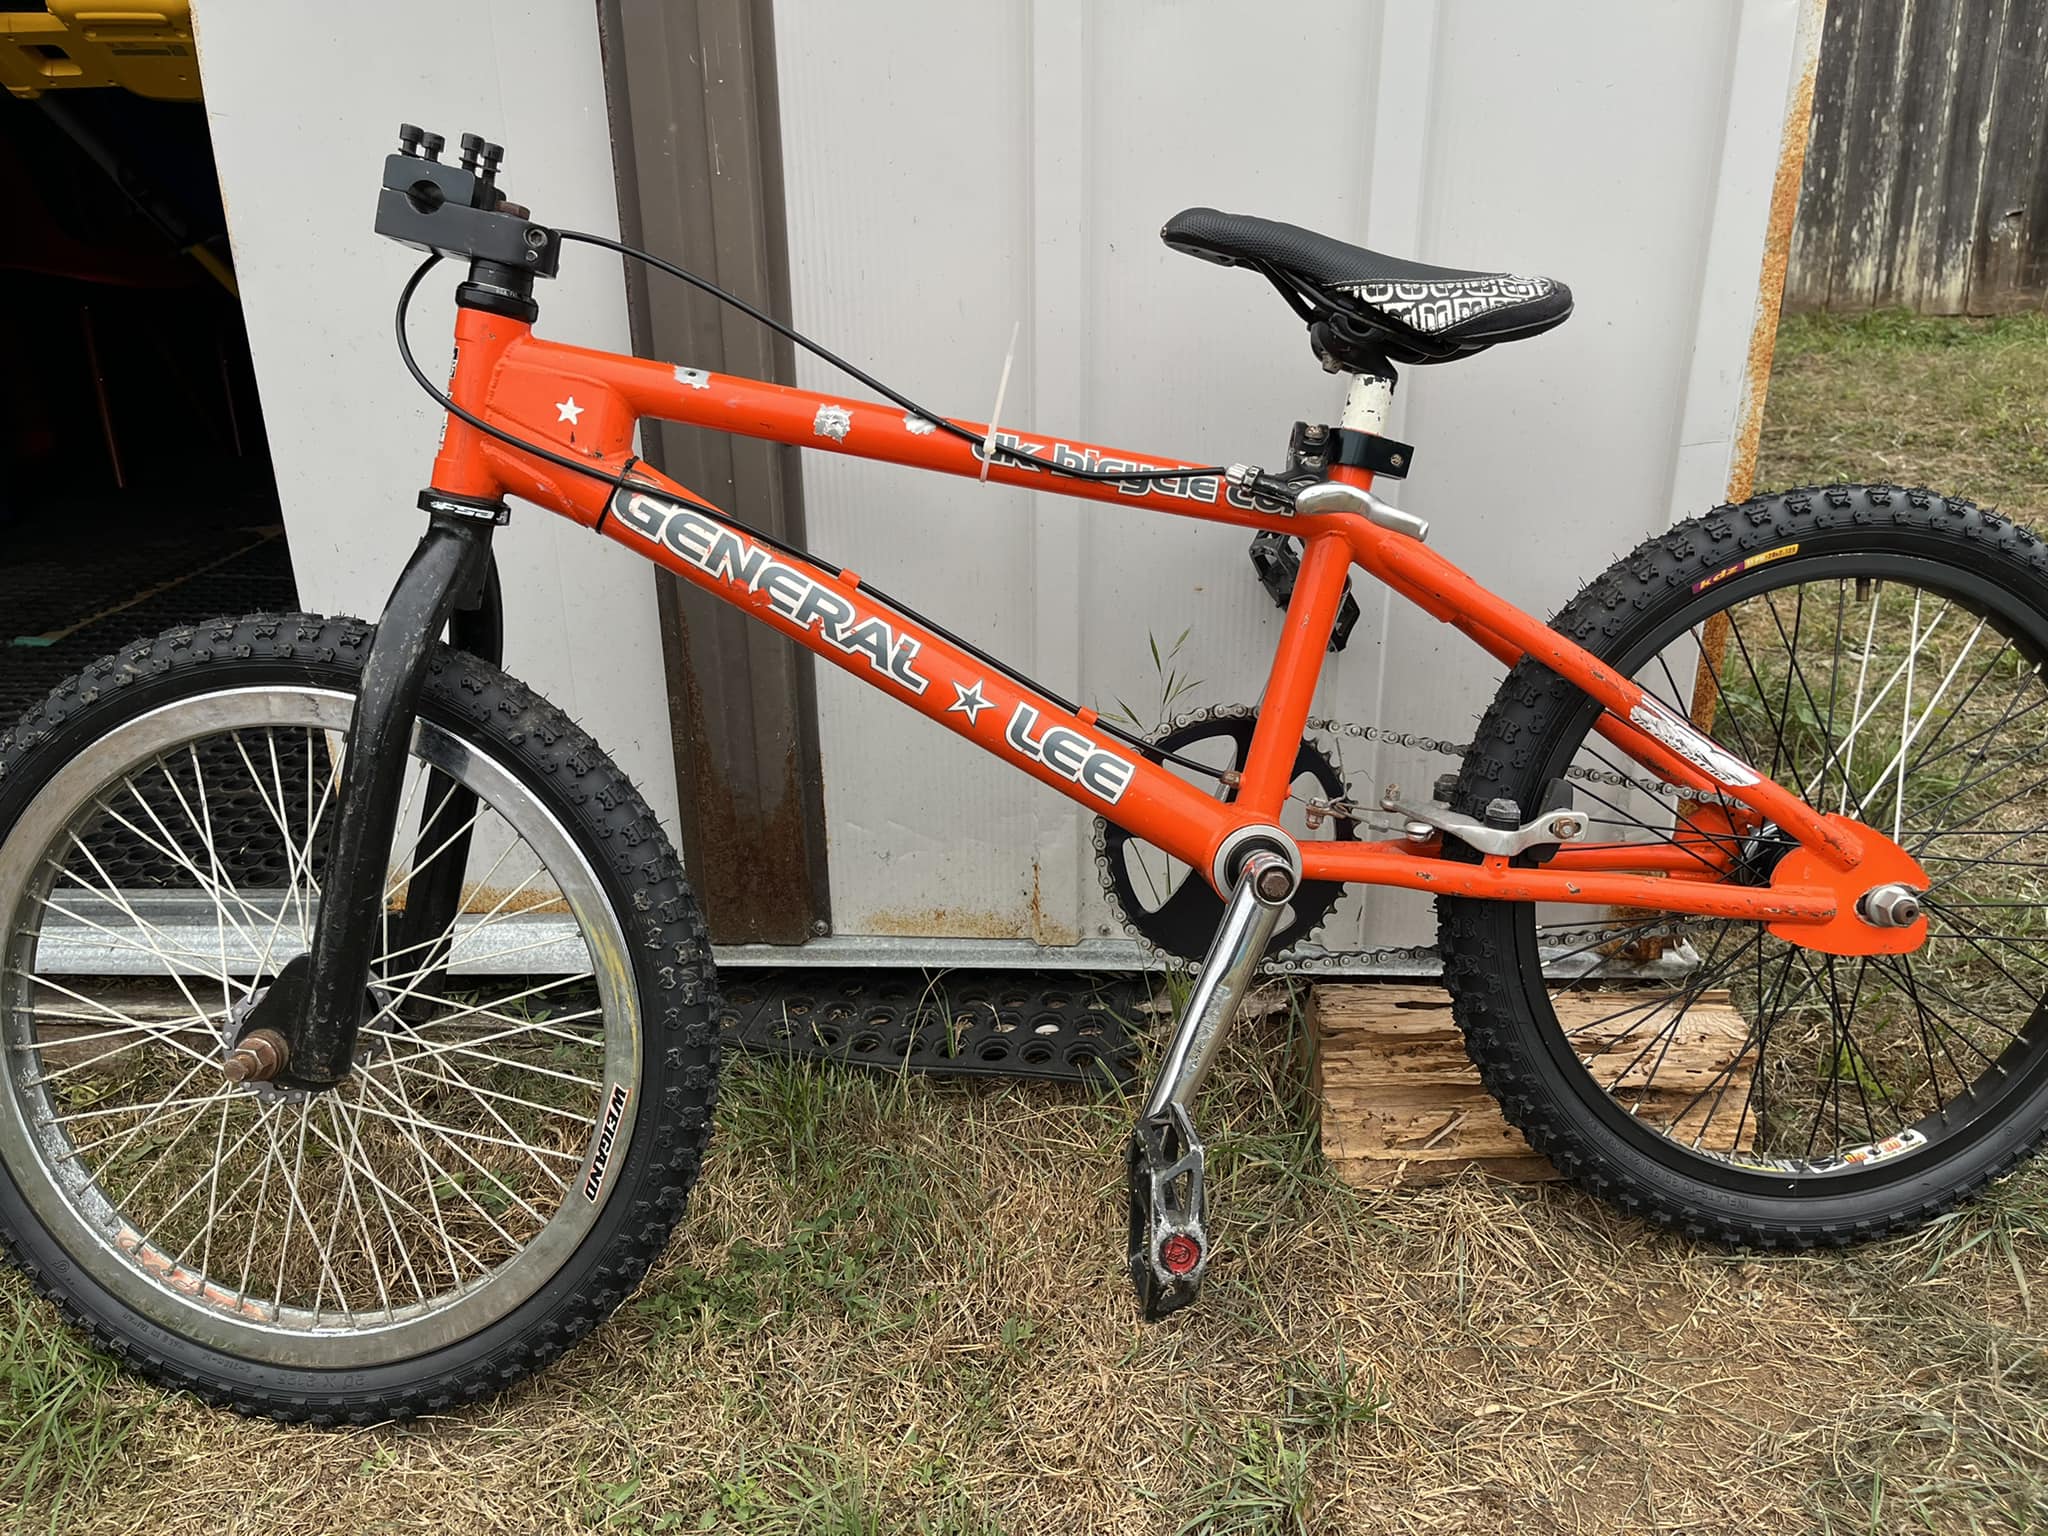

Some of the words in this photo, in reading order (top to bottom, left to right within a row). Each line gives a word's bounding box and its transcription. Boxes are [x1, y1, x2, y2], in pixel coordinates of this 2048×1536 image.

[1051, 443, 1220, 504] bicycle
[611, 486, 931, 695] GENERAL
[1004, 700, 1136, 806] LEE
[583, 1083, 628, 1203] WEIGAND
